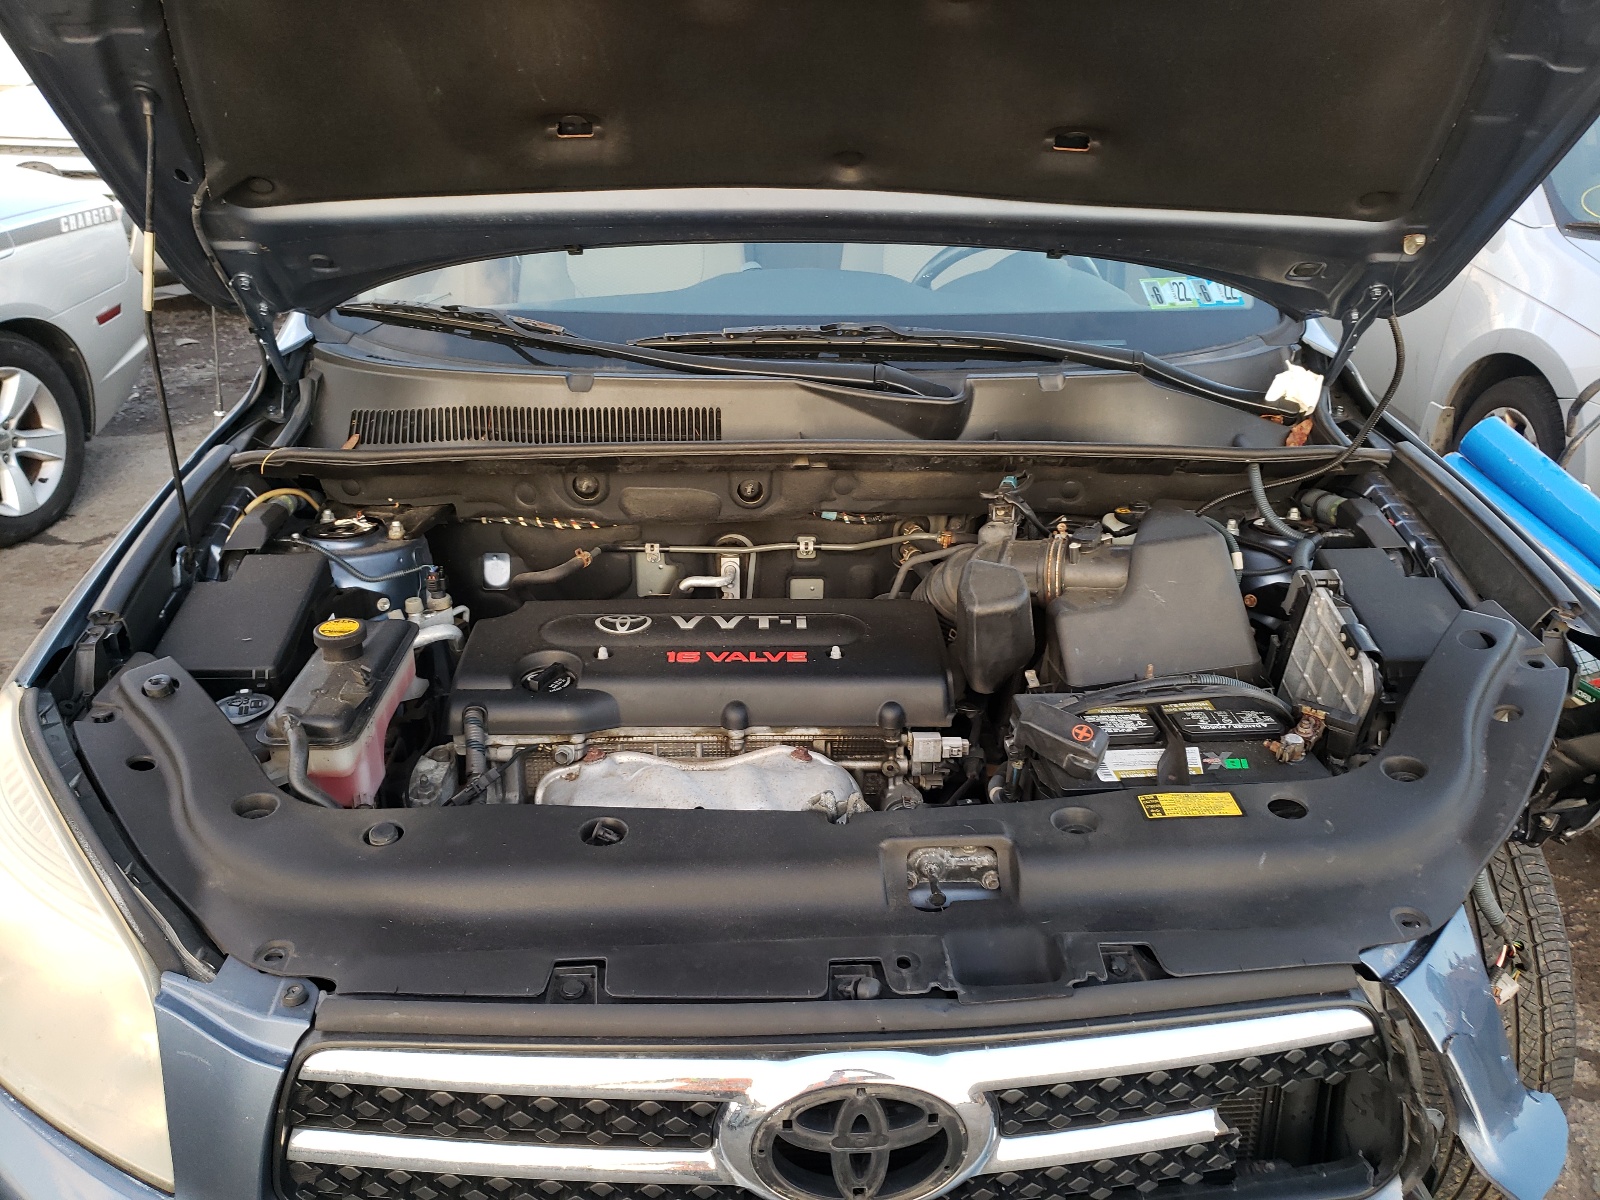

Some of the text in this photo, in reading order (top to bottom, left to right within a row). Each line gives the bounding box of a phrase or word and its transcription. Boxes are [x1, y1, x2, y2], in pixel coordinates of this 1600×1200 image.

[60, 207, 113, 233] CHARGER
[667, 651, 808, 663] 16 VALVE
